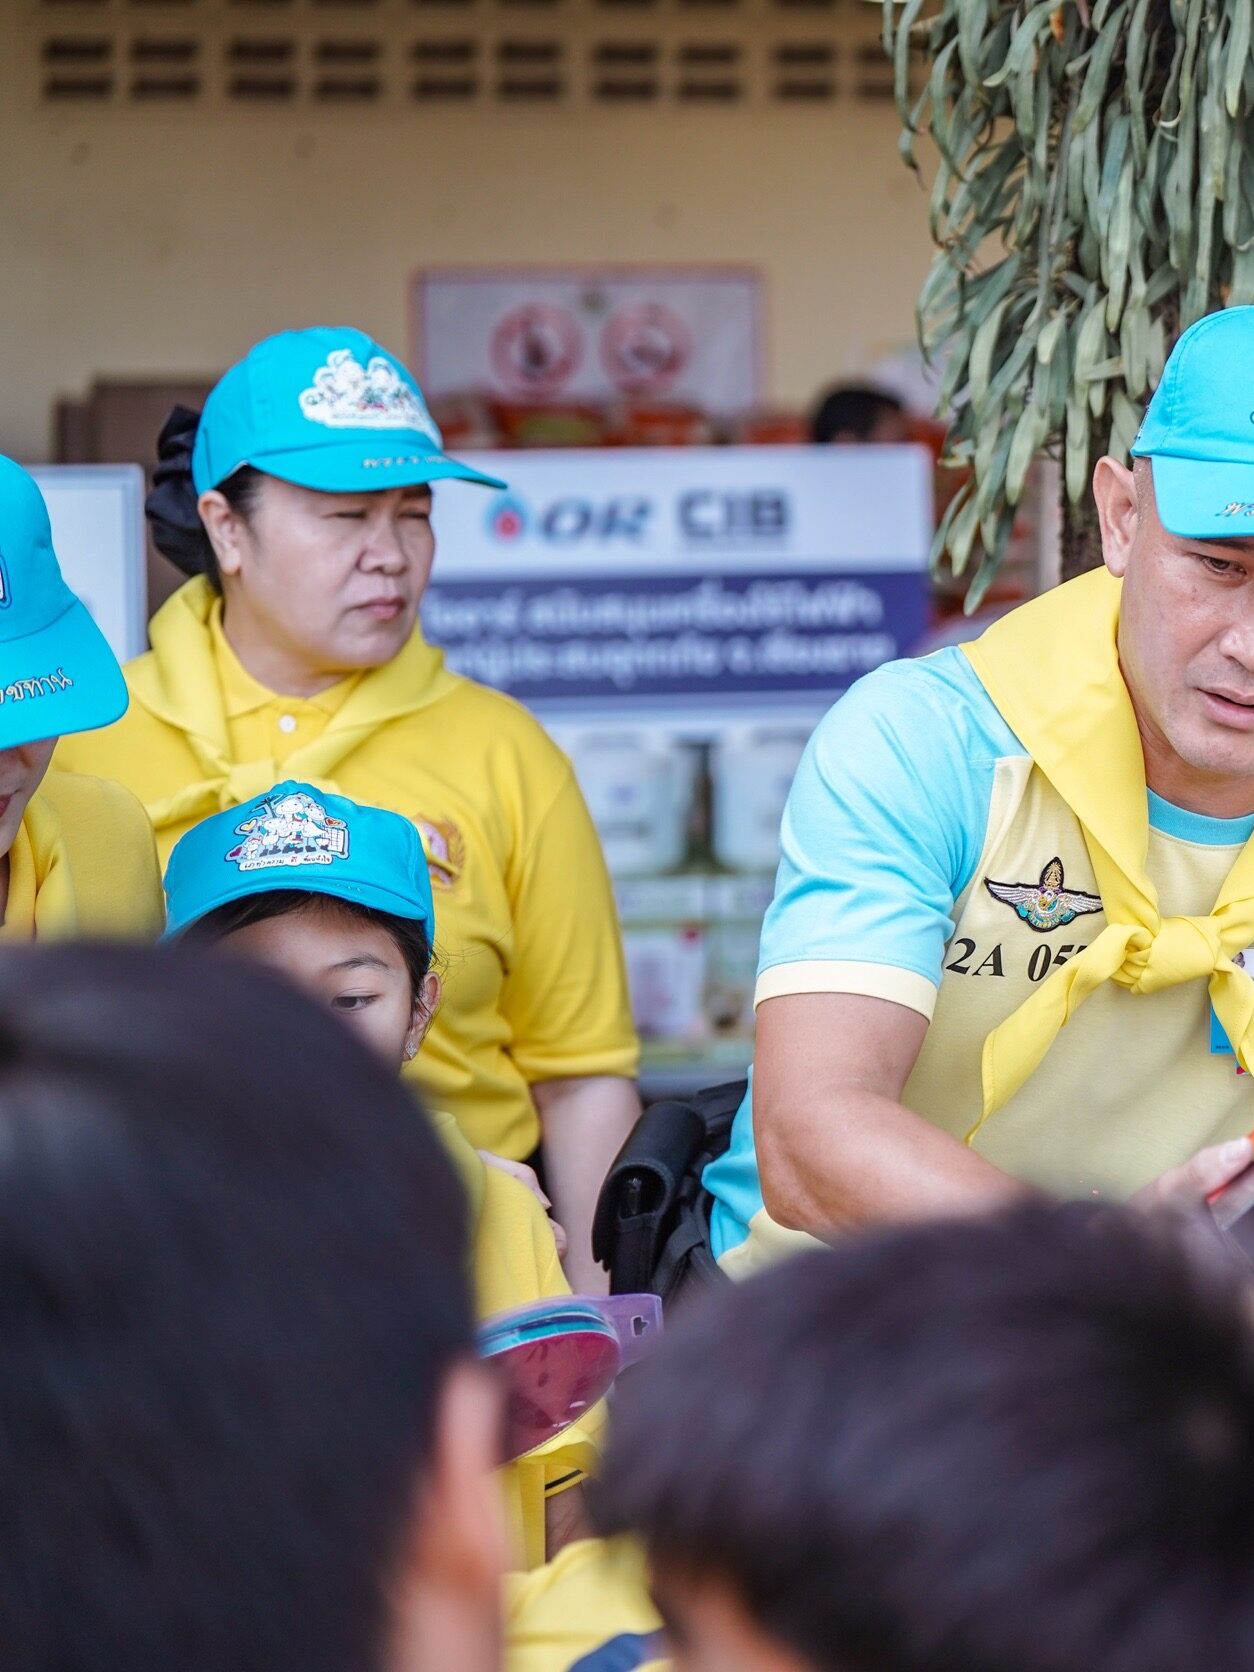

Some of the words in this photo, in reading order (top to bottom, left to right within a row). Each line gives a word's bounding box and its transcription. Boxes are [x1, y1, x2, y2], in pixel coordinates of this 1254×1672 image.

[676, 487, 790, 542] CIB
[945, 938, 1005, 977] 2A
[1027, 944, 1088, 982] 05
